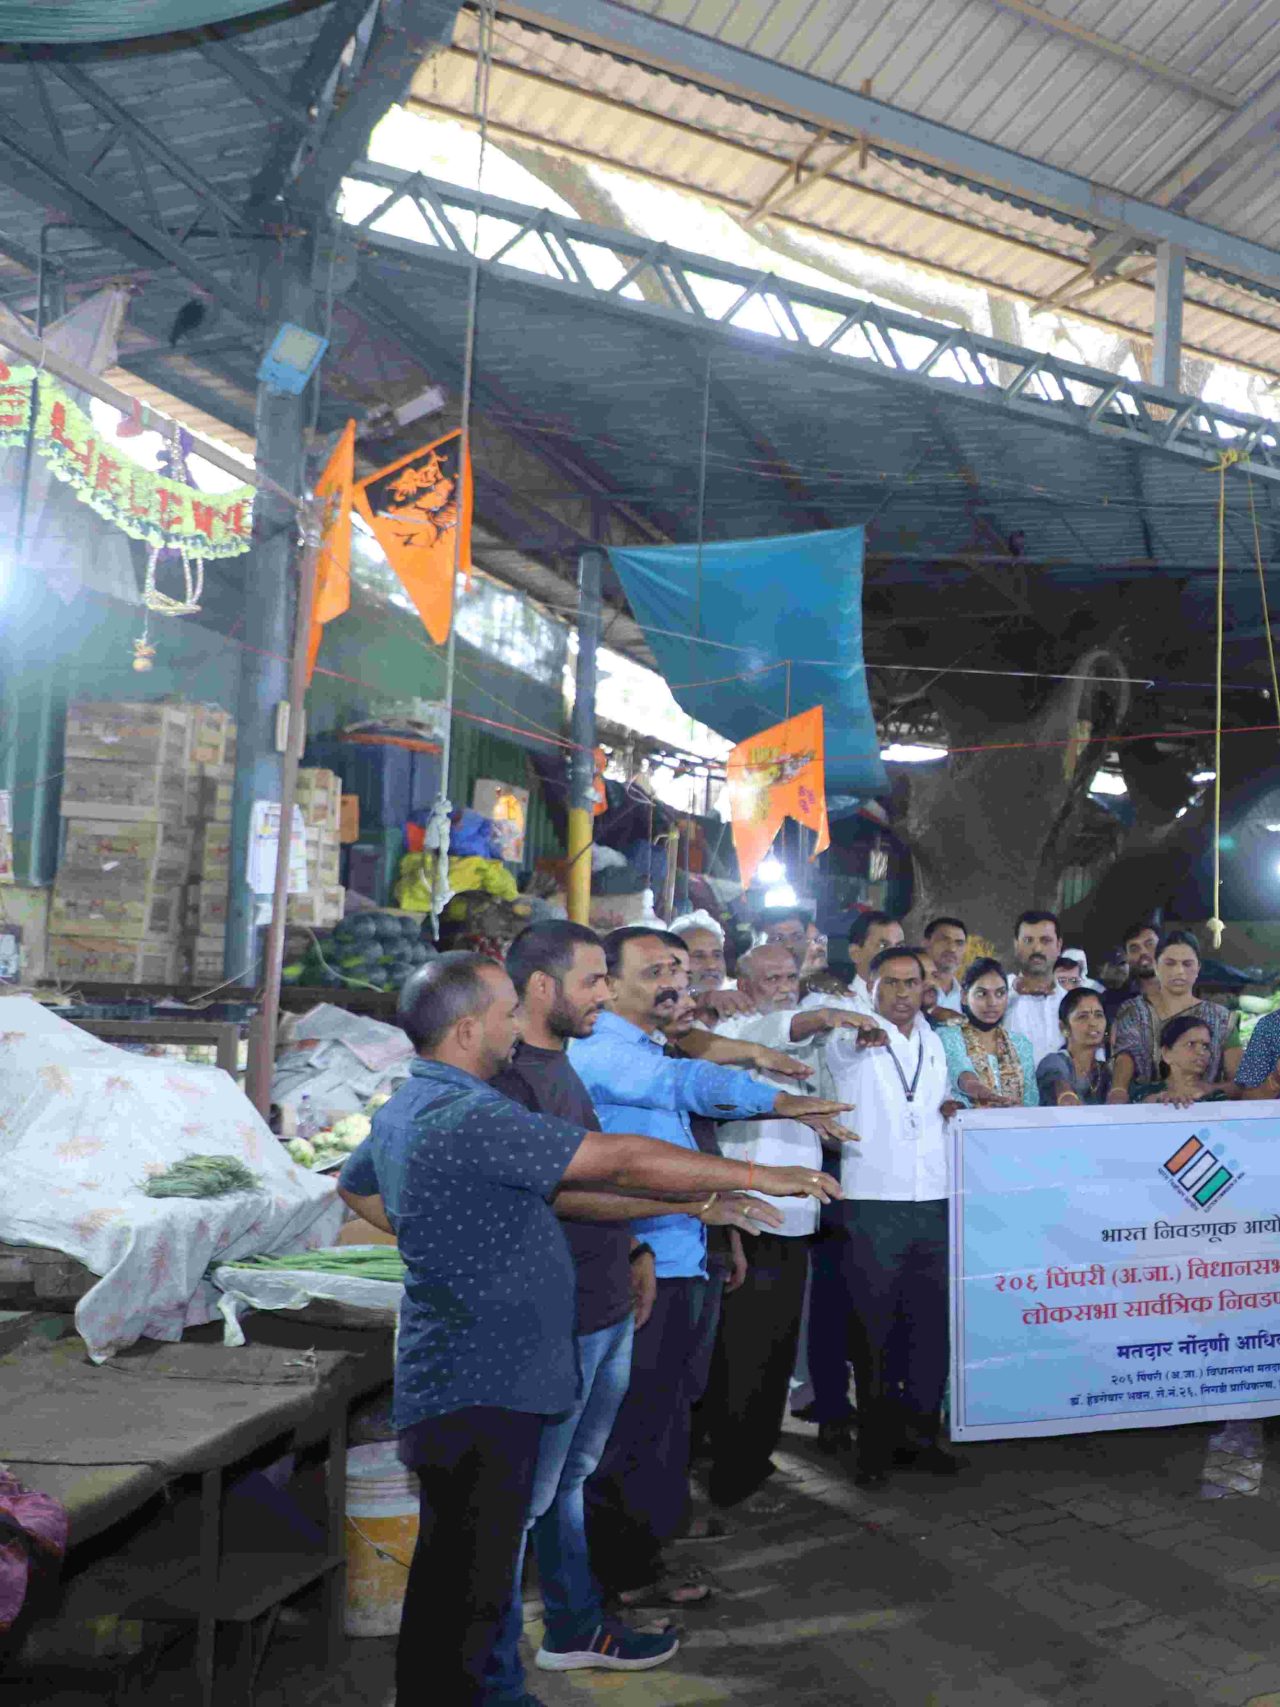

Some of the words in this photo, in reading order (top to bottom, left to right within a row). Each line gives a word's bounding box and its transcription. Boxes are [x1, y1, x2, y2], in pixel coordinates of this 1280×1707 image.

[1101, 1226, 1147, 1242] भारत
[1154, 1220, 1238, 1244] निवडणूक
[994, 1274, 1038, 1292] २०६
[1046, 1264, 1105, 1289] पिंपरी
[1112, 1264, 1181, 1288] (अ.जा.)
[1022, 1302, 1118, 1325] लोकसभा
[1124, 1292, 1215, 1318] सार्वत्रिक
[1117, 1341, 1173, 1361] मतदार
[1179, 1333, 1230, 1357] नोंदणी
[1111, 1374, 1134, 1385] २०६
[1206, 1365, 1254, 1377] विधानसभा
